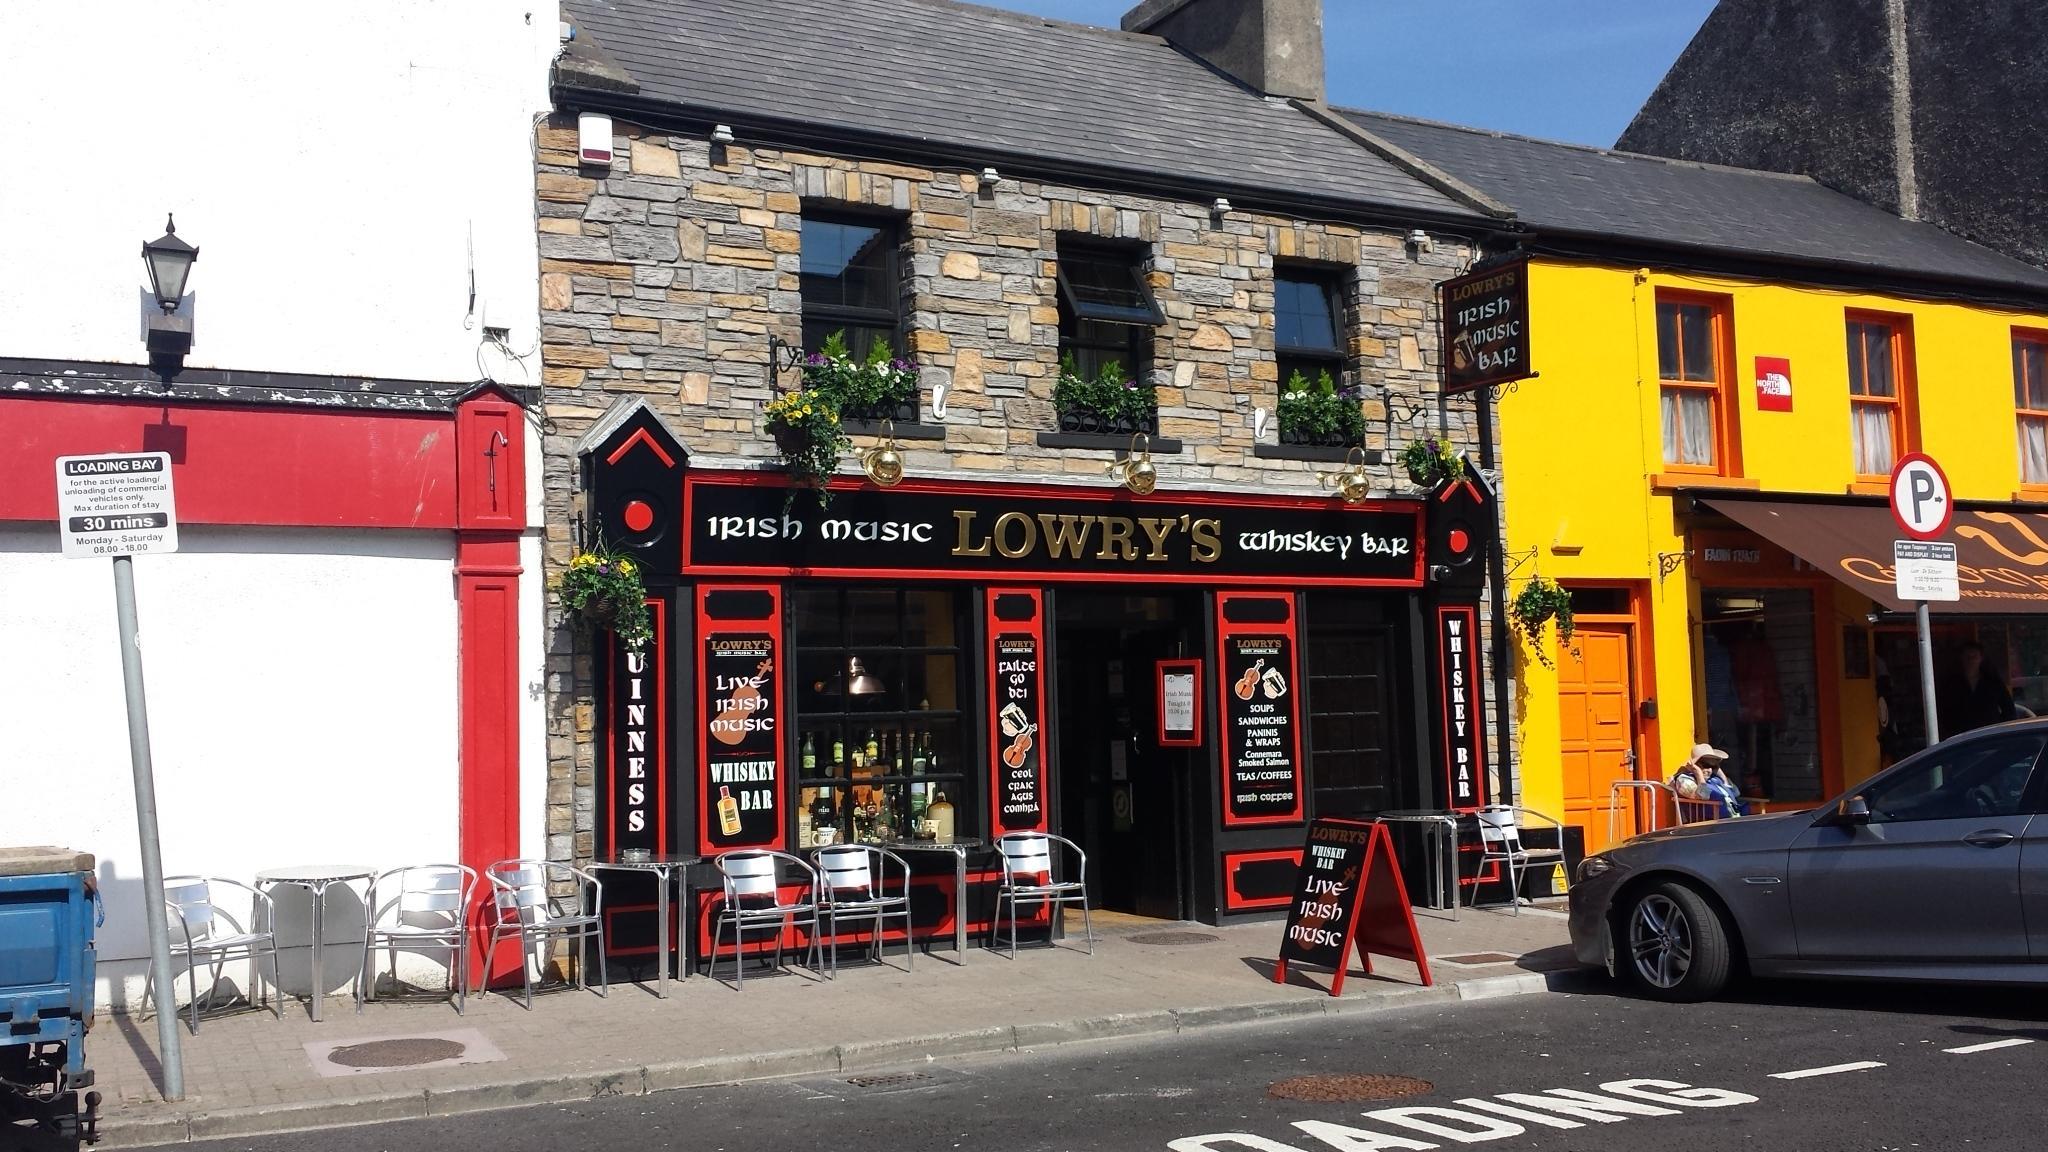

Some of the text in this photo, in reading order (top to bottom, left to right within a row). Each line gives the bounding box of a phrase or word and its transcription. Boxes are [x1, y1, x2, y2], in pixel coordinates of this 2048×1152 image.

[1453, 272, 1515, 301] LOWRY'S
[1458, 297, 1510, 326] IRISH
[1473, 320, 1520, 345] MUSIC
[1478, 346, 1517, 370] BAR
[1757, 379, 1780, 388] NORTH
[1766, 372, 1780, 381] THE
[1763, 387, 1780, 395] FACE
[69, 460, 157, 474] LOADING BAY
[70, 479, 82, 487] for
[83, 478, 97, 486] the
[99, 477, 125, 485] active
[65, 484, 167, 496] unloading of commercial
[1910, 470, 1935, 524] P
[89, 494, 123, 502] vehicles
[74, 504, 92, 512] Max
[94, 502, 129, 511] duration
[142, 501, 160, 510] stay
[83, 516, 154, 531] 30 mins
[76, 536, 113, 546] Monday
[121, 533, 163, 543] Saturday
[707, 510, 1409, 563] IRISH MUSIC LOWRY'S WHISKEY BAR
[711, 640, 772, 650] LOWRY'S
[1237, 640, 1282, 648] LOWRY'S
[716, 675, 769, 690] LIVE
[1010, 673, 1025, 686] GO
[715, 695, 768, 713] IRISH
[1250, 704, 1274, 713] SOUPS
[1448, 620, 1470, 797] WHISKEY BAR
[710, 718, 774, 732] MUSIC
[1238, 716, 1287, 725] SANDWICHES
[626, 637, 646, 832] UINNESS
[1247, 729, 1278, 737] PANINIS
[1245, 738, 1281, 747] & WRAPS
[1238, 758, 1289, 767] Smoked Salmon
[710, 761, 775, 783] WHISKEY
[1011, 768, 1033, 778] CEOL
[1008, 781, 1034, 791] CRAIC
[740, 790, 772, 810] BAR
[1011, 792, 1034, 802] AGUS
[1311, 826, 1367, 844] LOWRY'S
[1312, 845, 1347, 860] WHISKEY
[1316, 858, 1334, 870] BAR
[1305, 875, 1350, 896] LIVE
[1300, 900, 1343, 922] IRISH
[1289, 925, 1342, 948] MUSIC
[1167, 1078, 1760, 1152] OADING
